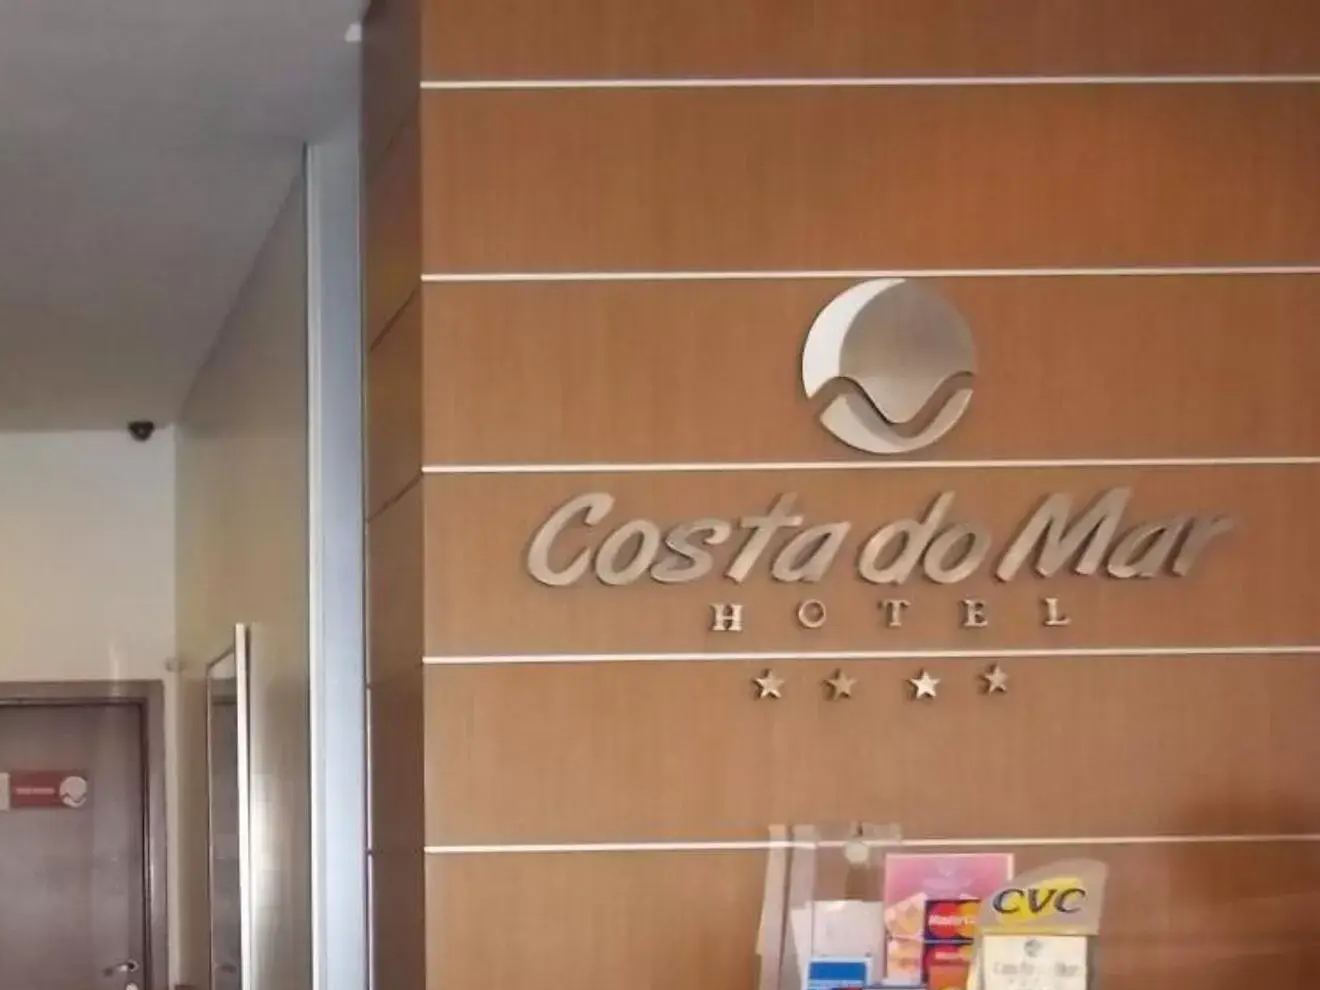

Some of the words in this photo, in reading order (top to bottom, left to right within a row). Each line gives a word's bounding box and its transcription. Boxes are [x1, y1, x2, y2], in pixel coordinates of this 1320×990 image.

[527, 490, 852, 586] Costa
[858, 490, 994, 585] do
[997, 487, 1239, 581] Mar
[710, 598, 1071, 633] HOTEL
[992, 888, 1086, 915] CVC
